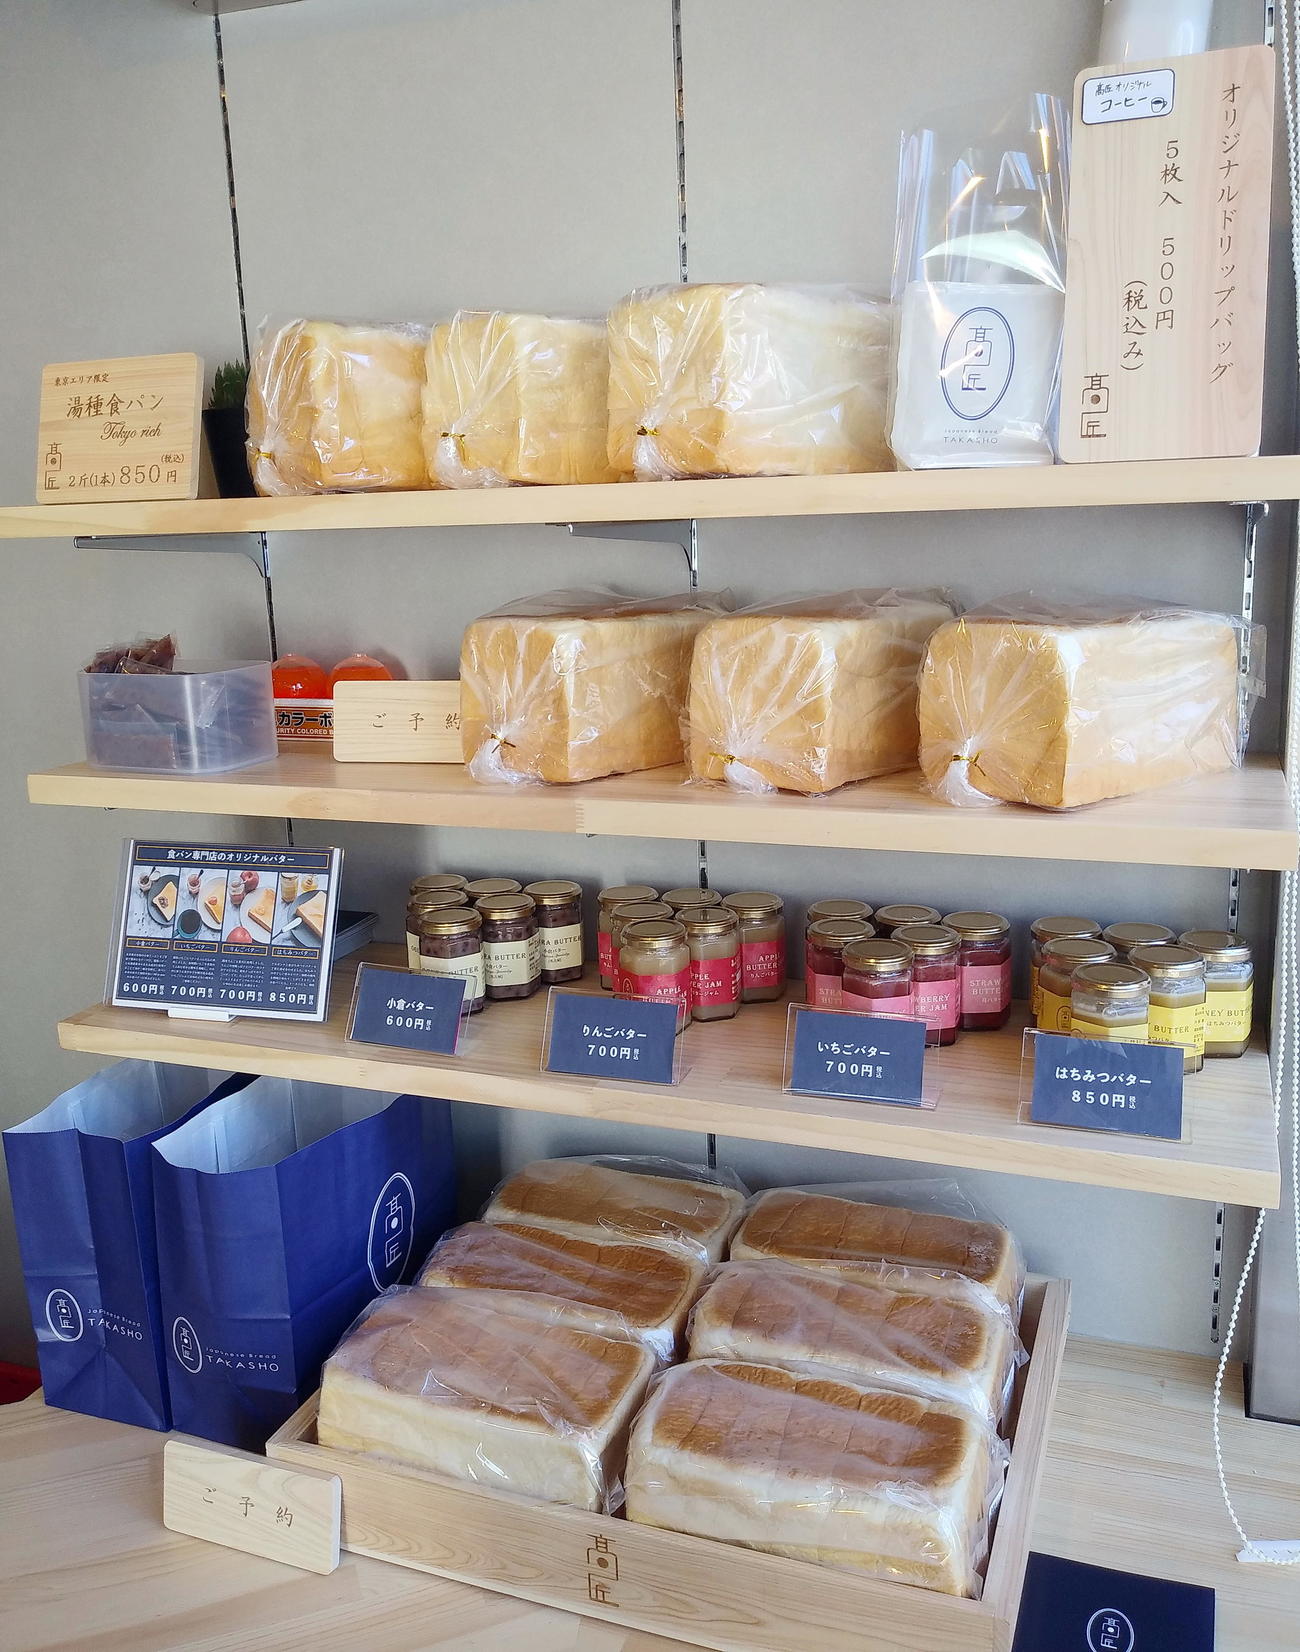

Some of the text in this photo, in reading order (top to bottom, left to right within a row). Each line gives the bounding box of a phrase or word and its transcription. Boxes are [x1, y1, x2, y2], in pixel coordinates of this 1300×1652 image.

[1100, 96, 1148, 113] コーヒー
[1155, 139, 1184, 330] 5枚入 500円
[1210, 83, 1241, 384] オリジナルドリップバッグ
[1120, 280, 1148, 371] (税込み)
[54, 372, 110, 387] 東京エリア限定
[66, 393, 164, 418] 湯種食パン
[100, 421, 162, 447] Tokyo rich
[943, 436, 998, 444] TAKASHO
[372, 712, 461, 732] ご予約
[166, 849, 295, 864] 食パン専門店のオリジナルバター
[494, 952, 527, 961] BUTTER
[746, 962, 778, 971] BUTTER
[656, 985, 681, 996] APPLE
[704, 980, 722, 989] JAM
[386, 997, 435, 1012] 小倉バター
[929, 1003, 948, 1012] JAM
[582, 1024, 648, 1040] りんごバター
[1153, 1024, 1189, 1034] BUTTER
[817, 1041, 891, 1058] いちごバター
[1055, 1066, 1152, 1087] はちみつバター
[87, 1318, 143, 1341] TAKASHO
[205, 1354, 279, 1372] TAKASHO
[202, 1487, 294, 1528] ご予約
